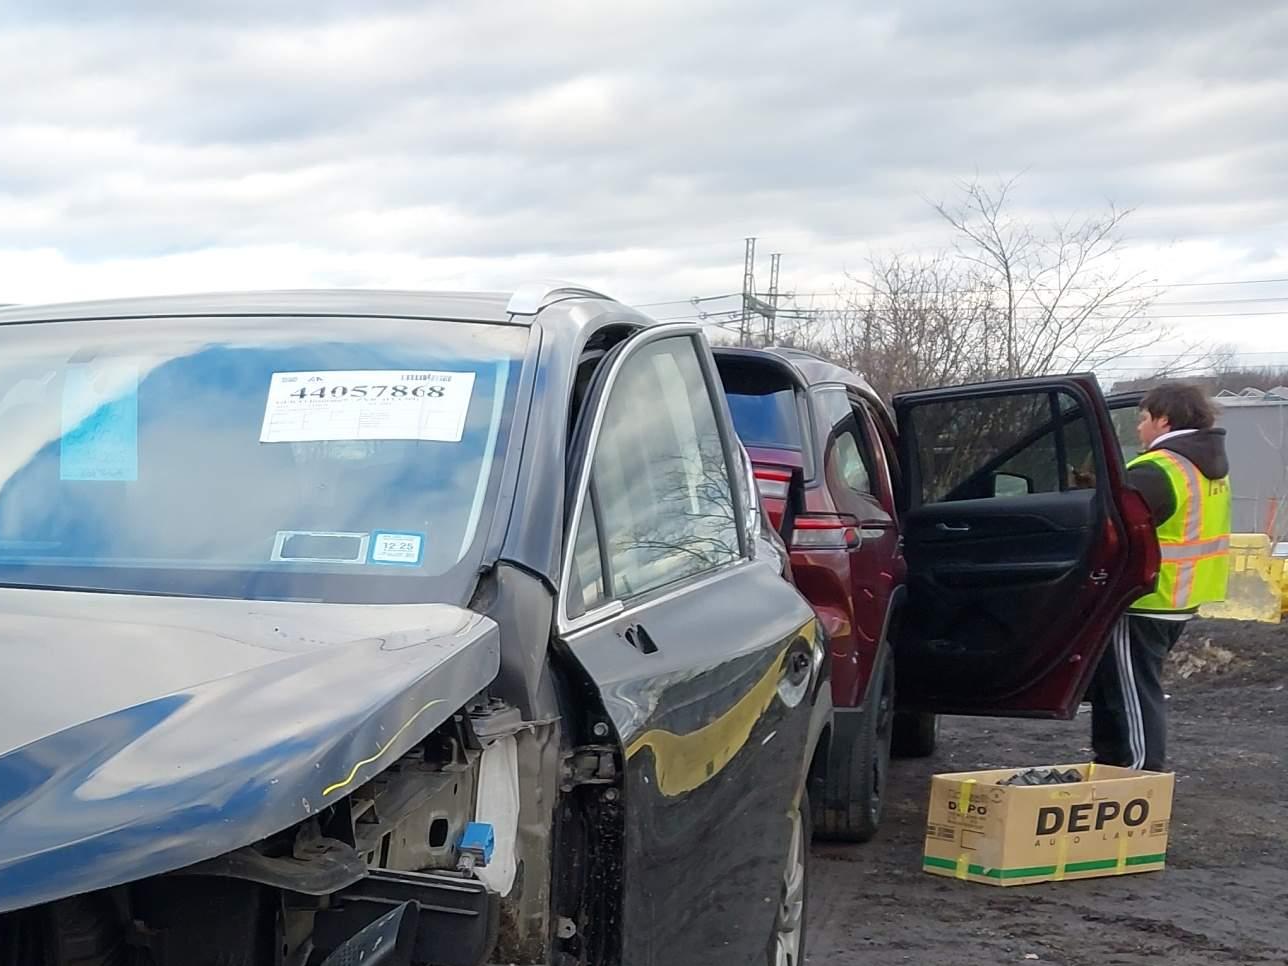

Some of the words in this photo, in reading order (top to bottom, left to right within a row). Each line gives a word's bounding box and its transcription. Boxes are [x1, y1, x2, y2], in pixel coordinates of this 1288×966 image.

[289, 385, 446, 399] 44057868
[948, 801, 987, 815] DPO
[1035, 798, 1150, 836] DEPO
[1034, 836, 1081, 847] AUO
